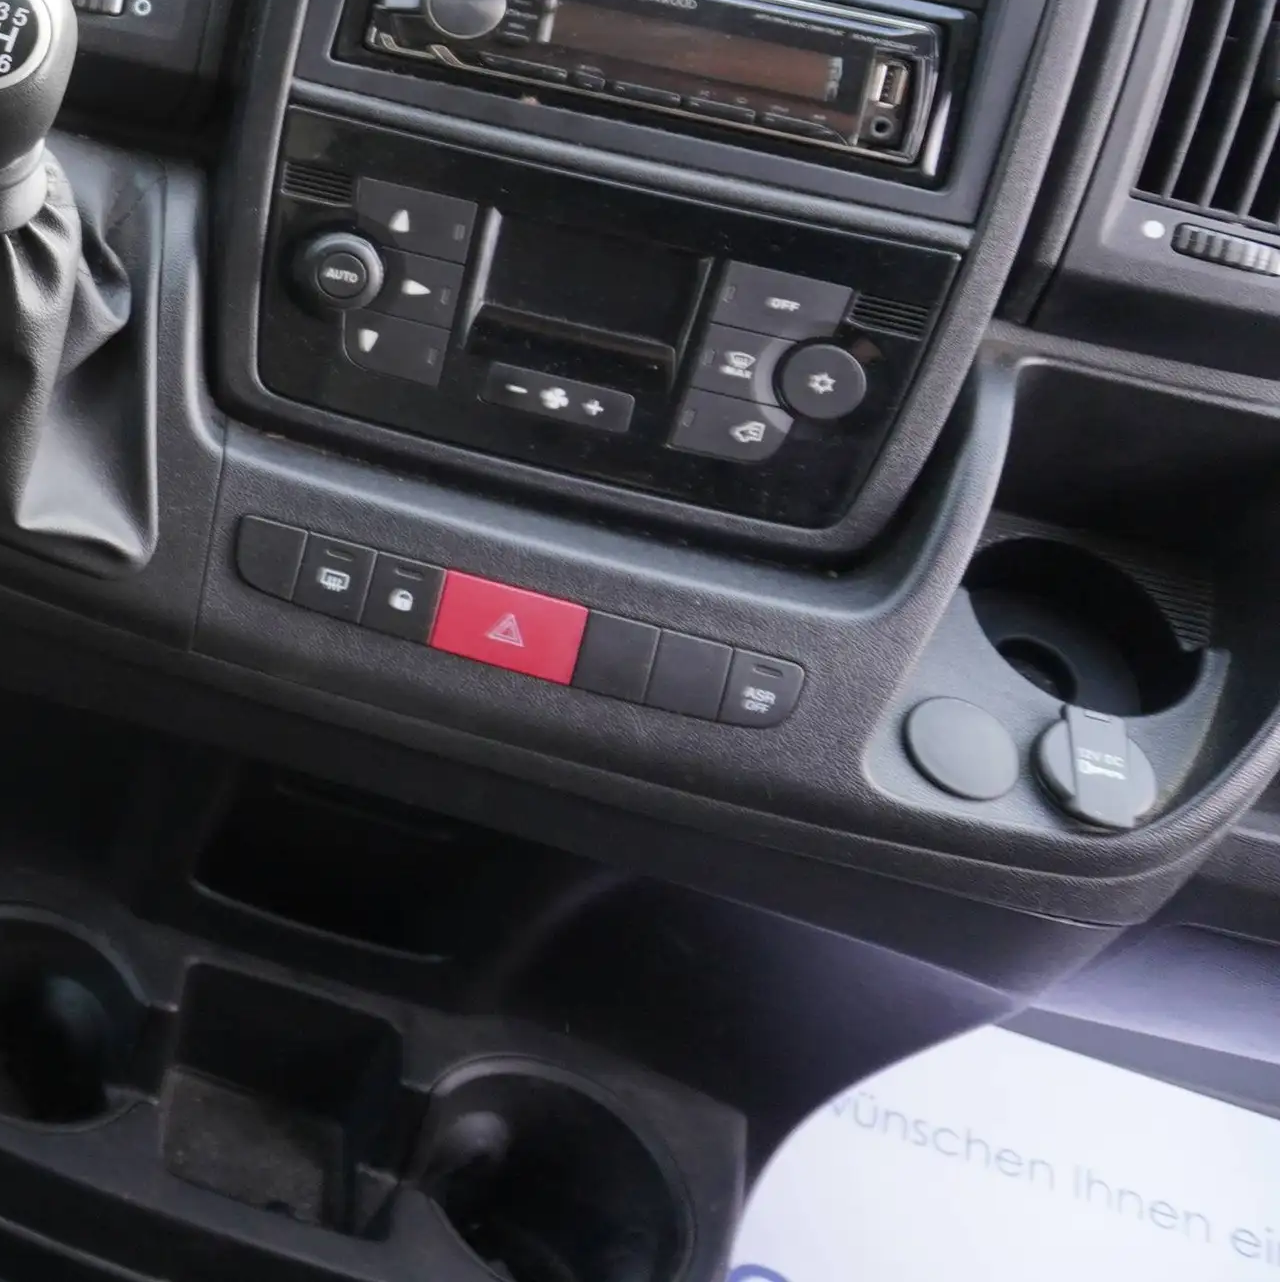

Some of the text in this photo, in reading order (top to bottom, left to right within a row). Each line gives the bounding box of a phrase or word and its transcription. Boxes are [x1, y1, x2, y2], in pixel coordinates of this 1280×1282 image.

[12, 7, 30, 27] 5
[324, 267, 359, 284] AUTO
[763, 297, 801, 311] OFF
[742, 685, 776, 705] ASR
[742, 699, 771, 714] OFF
[1072, 1163, 1213, 1245] Ihnen
[1228, 1225, 1280, 1269] ei
